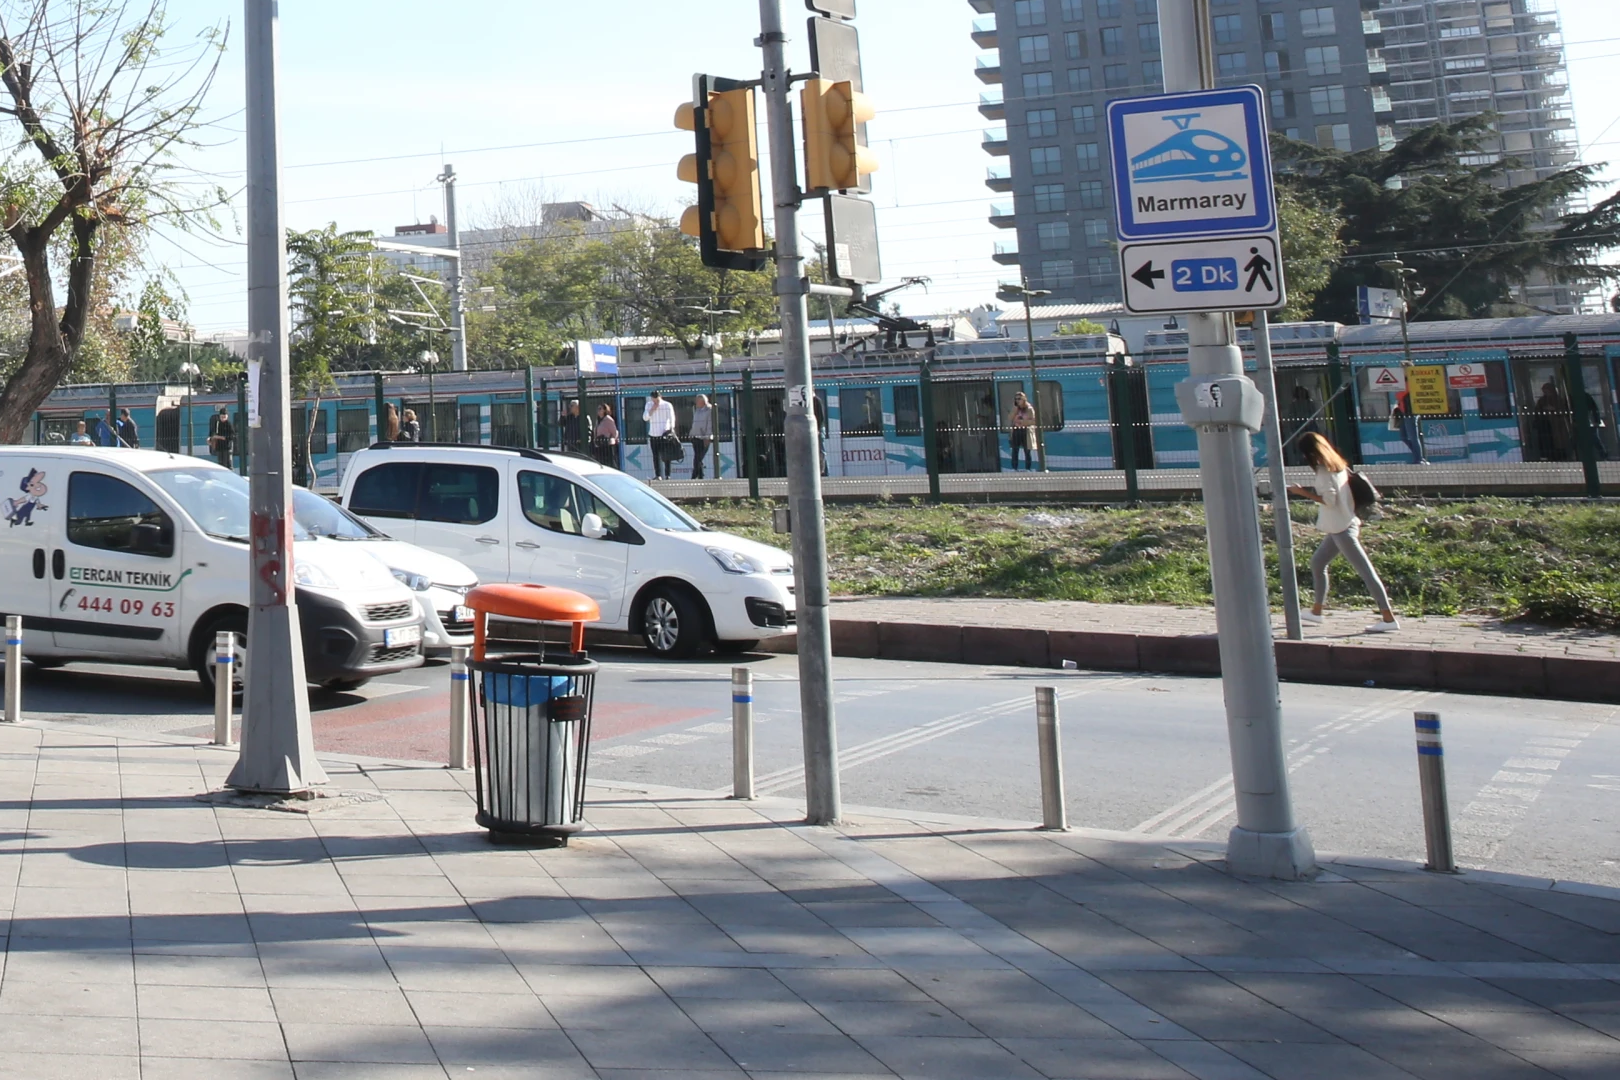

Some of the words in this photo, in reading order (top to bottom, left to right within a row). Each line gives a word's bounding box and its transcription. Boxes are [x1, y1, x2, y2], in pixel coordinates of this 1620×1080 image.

[1137, 192, 1247, 213] Marmaray
[1176, 267, 1193, 285] 2
[1202, 266, 1233, 284] Dk
[126, 571, 171, 588] TEKNİK
[77, 596, 113, 613] 444
[120, 598, 144, 615] 09
[151, 601, 175, 618] 63
